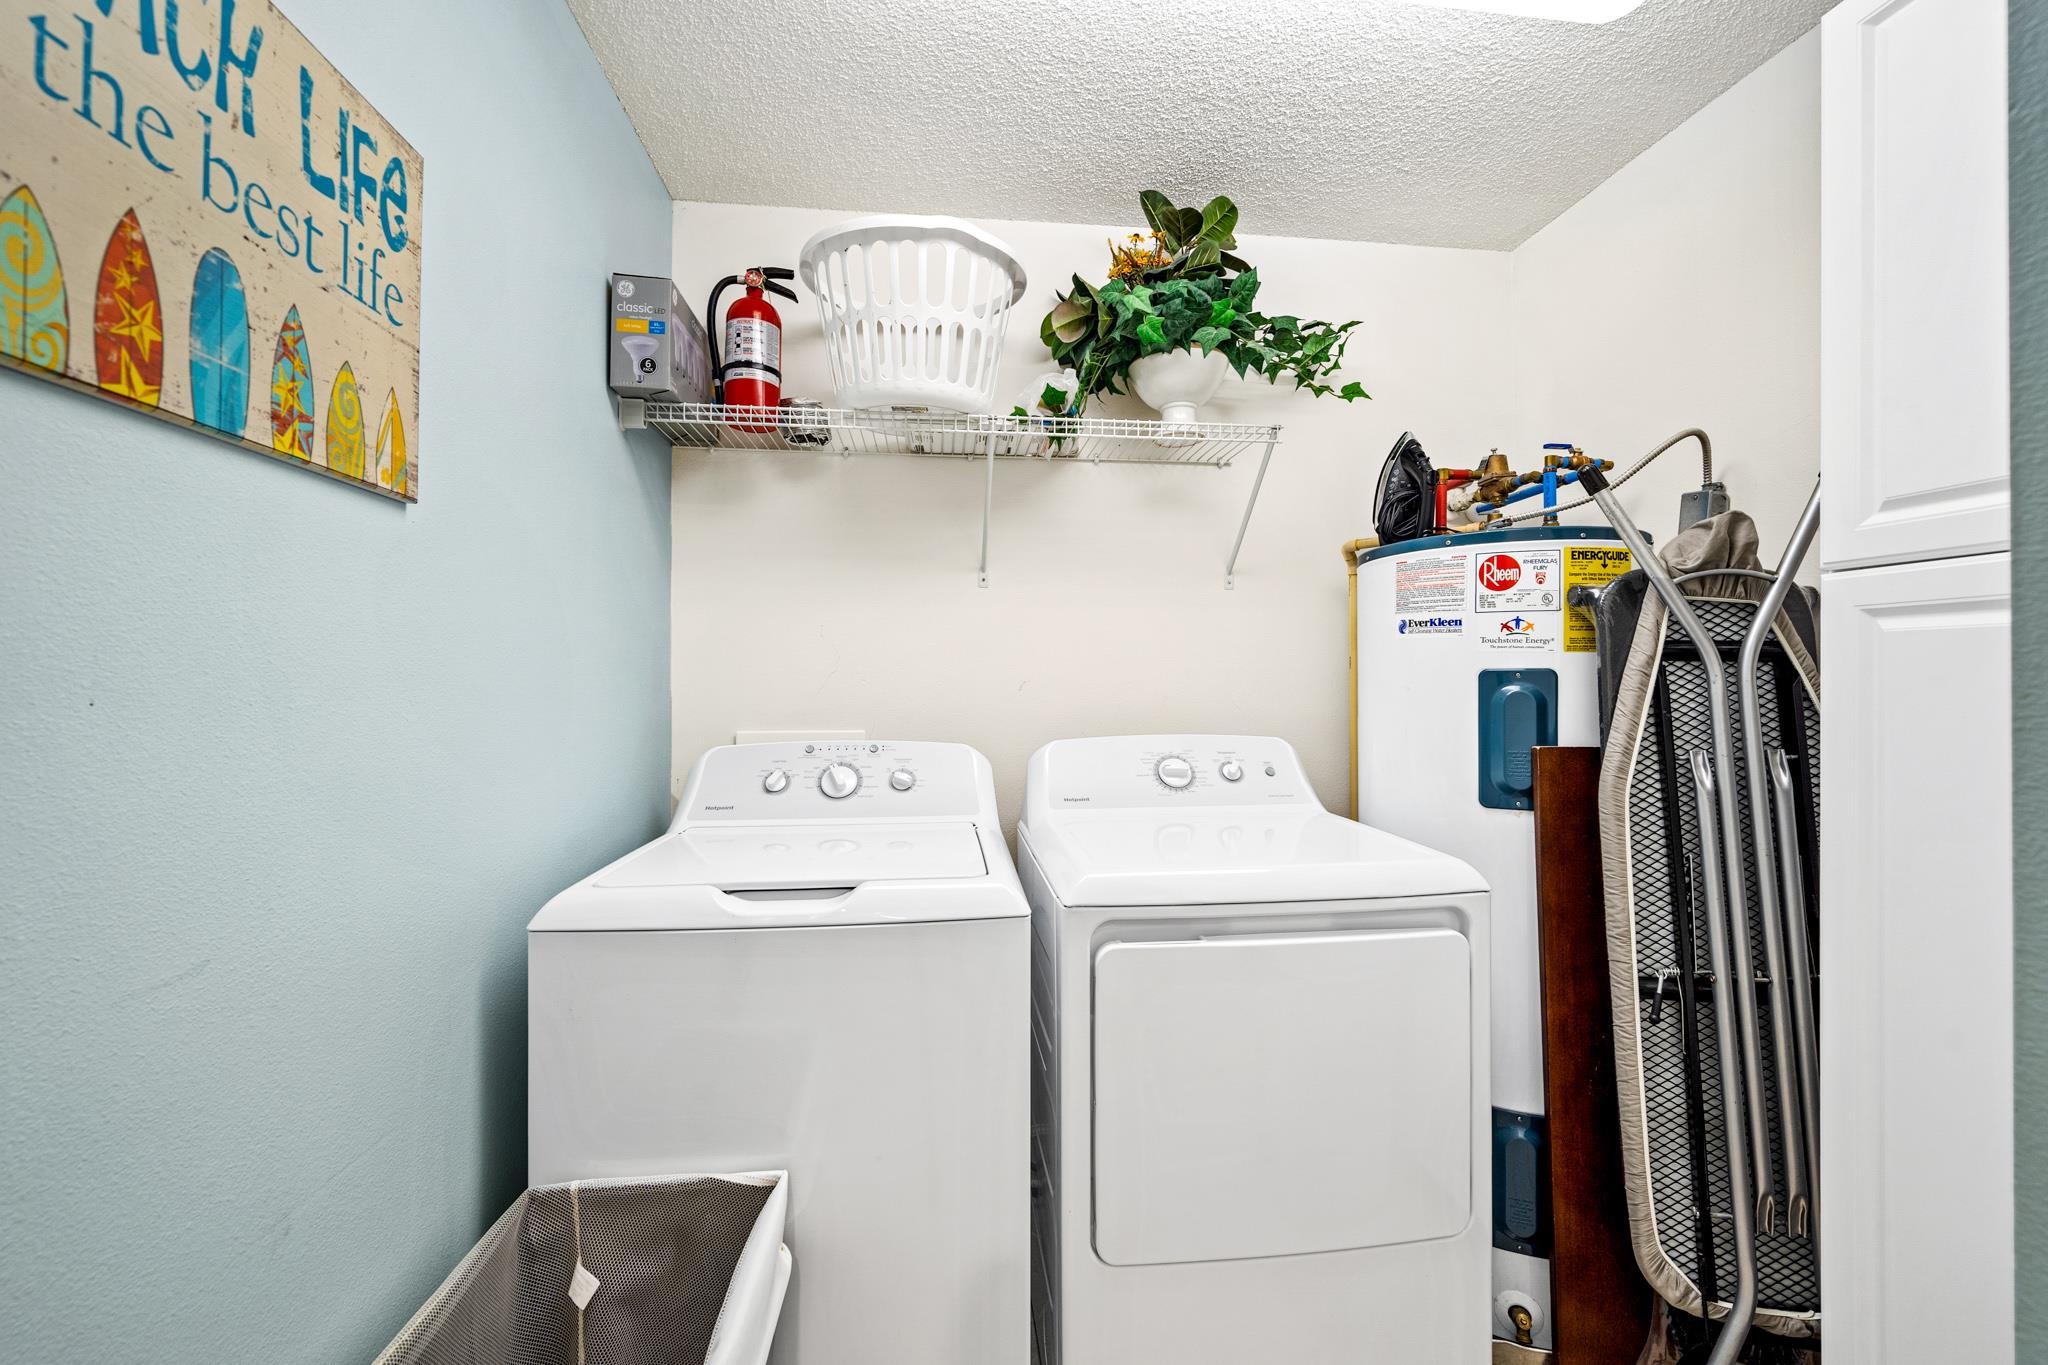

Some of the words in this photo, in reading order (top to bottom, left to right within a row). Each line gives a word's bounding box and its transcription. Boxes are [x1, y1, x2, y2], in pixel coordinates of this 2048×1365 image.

[28, 13, 175, 172] the
[197, 110, 324, 274] best
[337, 219, 403, 326] life
[616, 300, 653, 314] classic
[654, 307, 666, 315] LED
[645, 359, 652, 368] 6
[1571, 550, 1629, 562] ENERGYGUIDE
[1483, 556, 1520, 587] Rheem
[1408, 617, 1463, 628] EverKleen
[1480, 636, 1523, 644] Touchstone
